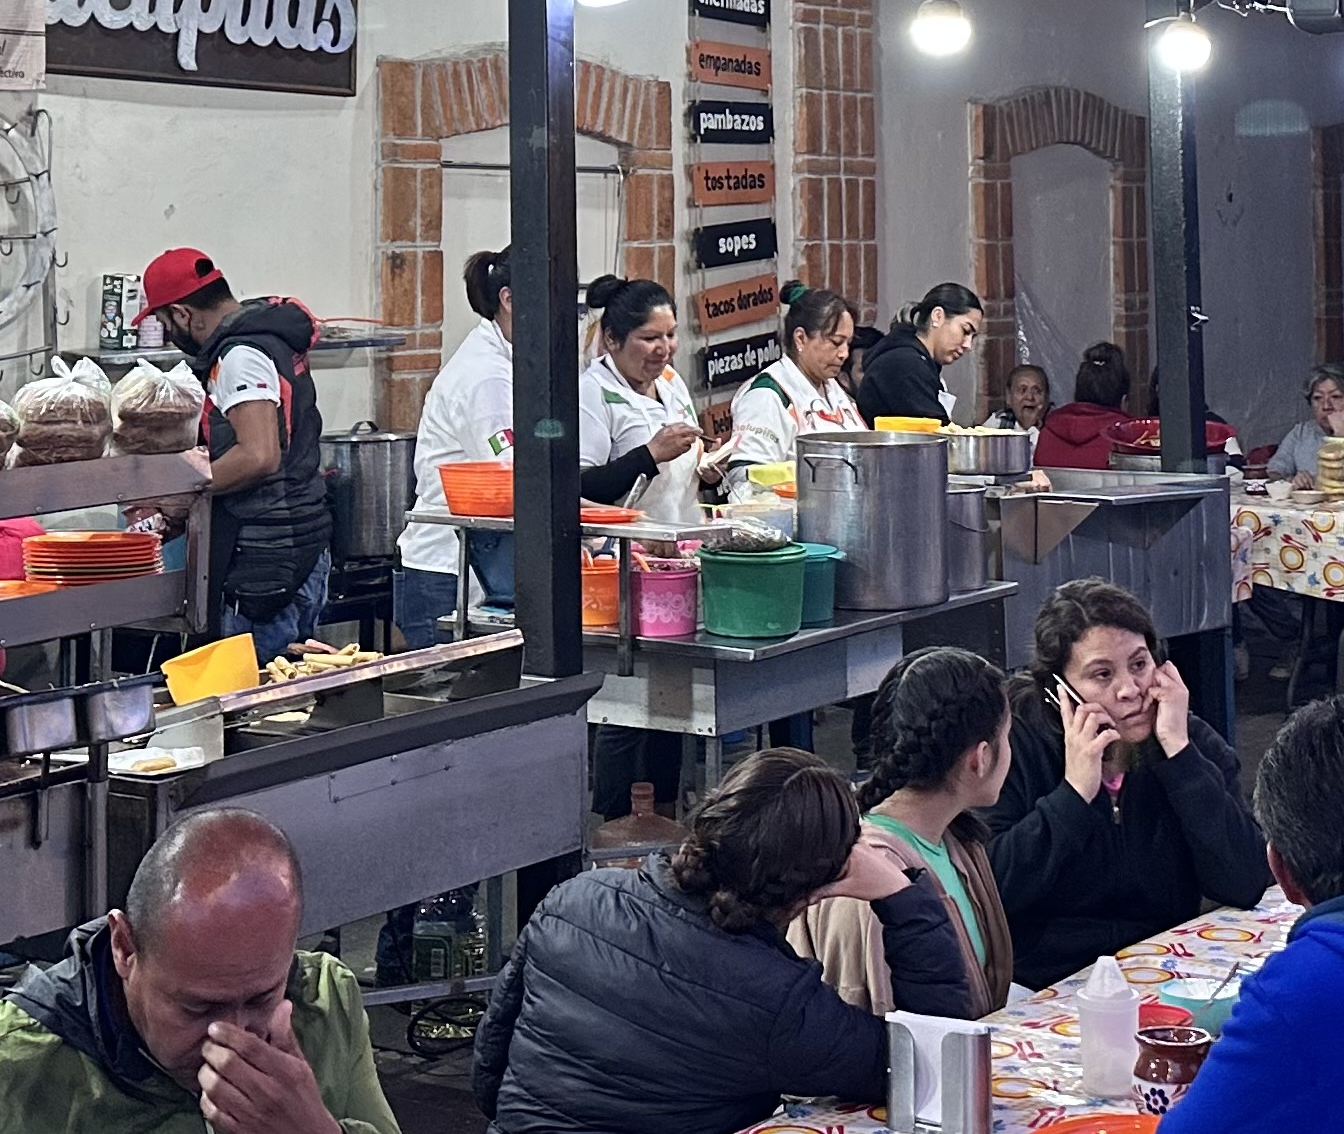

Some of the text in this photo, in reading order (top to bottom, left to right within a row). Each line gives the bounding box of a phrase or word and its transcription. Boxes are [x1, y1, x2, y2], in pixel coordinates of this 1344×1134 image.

[698, 52, 762, 77] empanadas
[699, 108, 765, 135] pambazos
[703, 168, 766, 192] tostadas
[718, 232, 757, 257] sopes
[704, 283, 774, 319] tacos dorados
[707, 338, 782, 382] piezas de pollo
